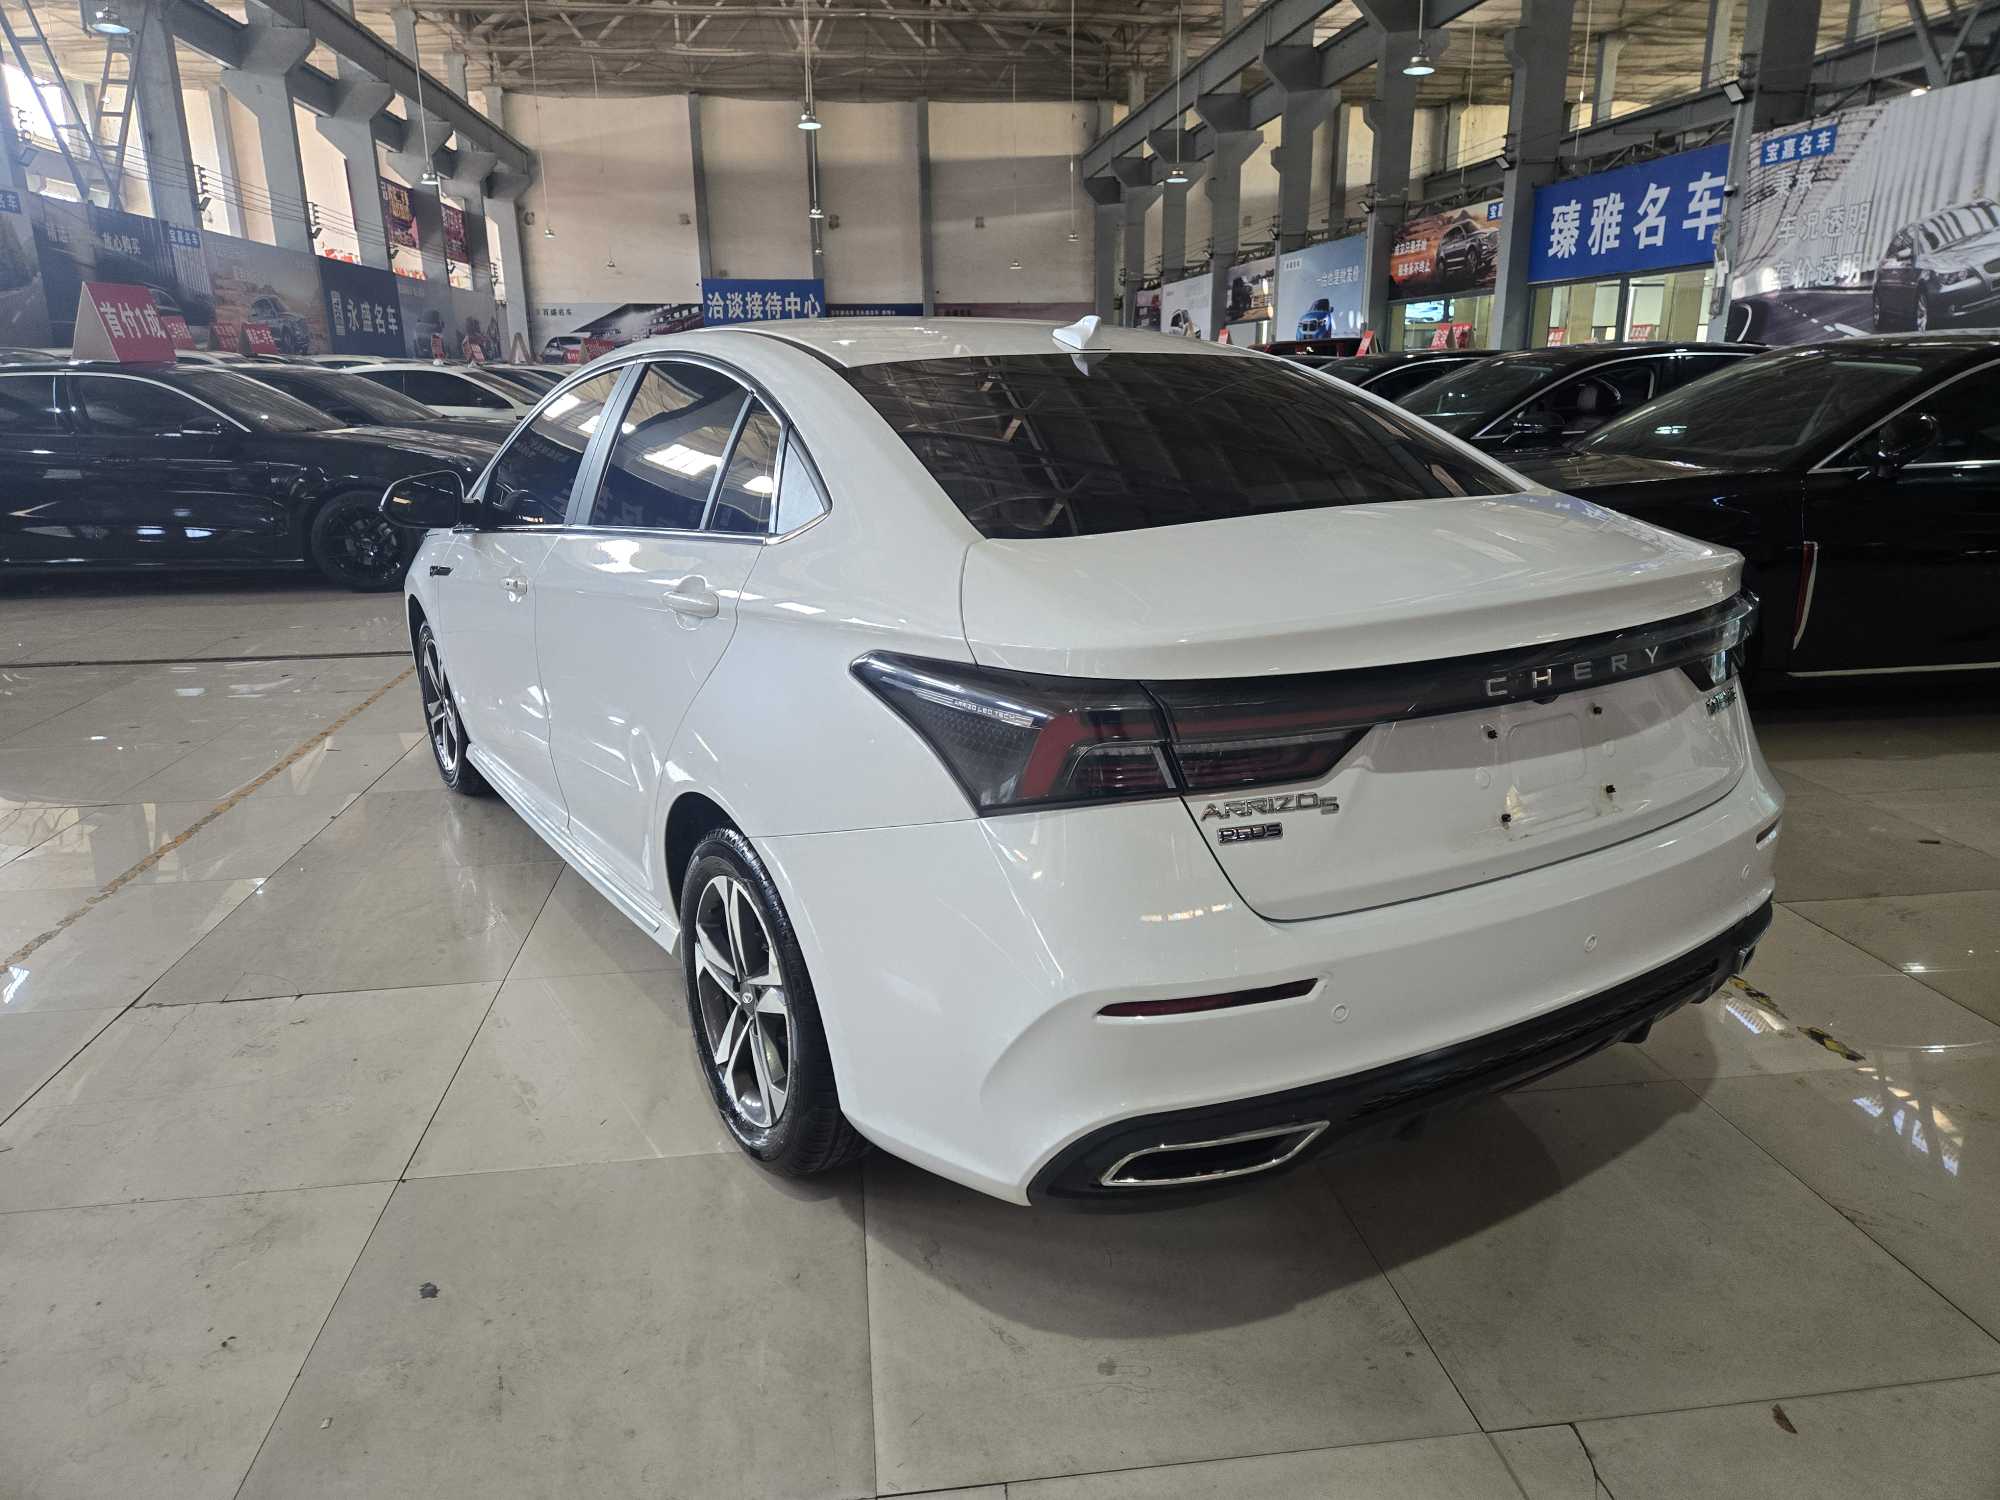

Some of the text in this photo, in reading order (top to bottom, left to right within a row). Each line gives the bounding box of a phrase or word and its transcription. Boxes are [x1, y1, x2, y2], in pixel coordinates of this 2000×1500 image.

[1765, 132, 1831, 162] 宝嘉名车
[1773, 165, 1815, 199] 秉承
[1548, 171, 1725, 259] 臻雅名车
[1778, 202, 1871, 245] 车况透明
[1775, 253, 1863, 289] 车价透明
[100, 302, 167, 339] 首付1成
[346, 298, 399, 335] 永盛名车
[707, 291, 821, 318] 洽谈接待中心
[1487, 646, 1658, 697] CHERY
